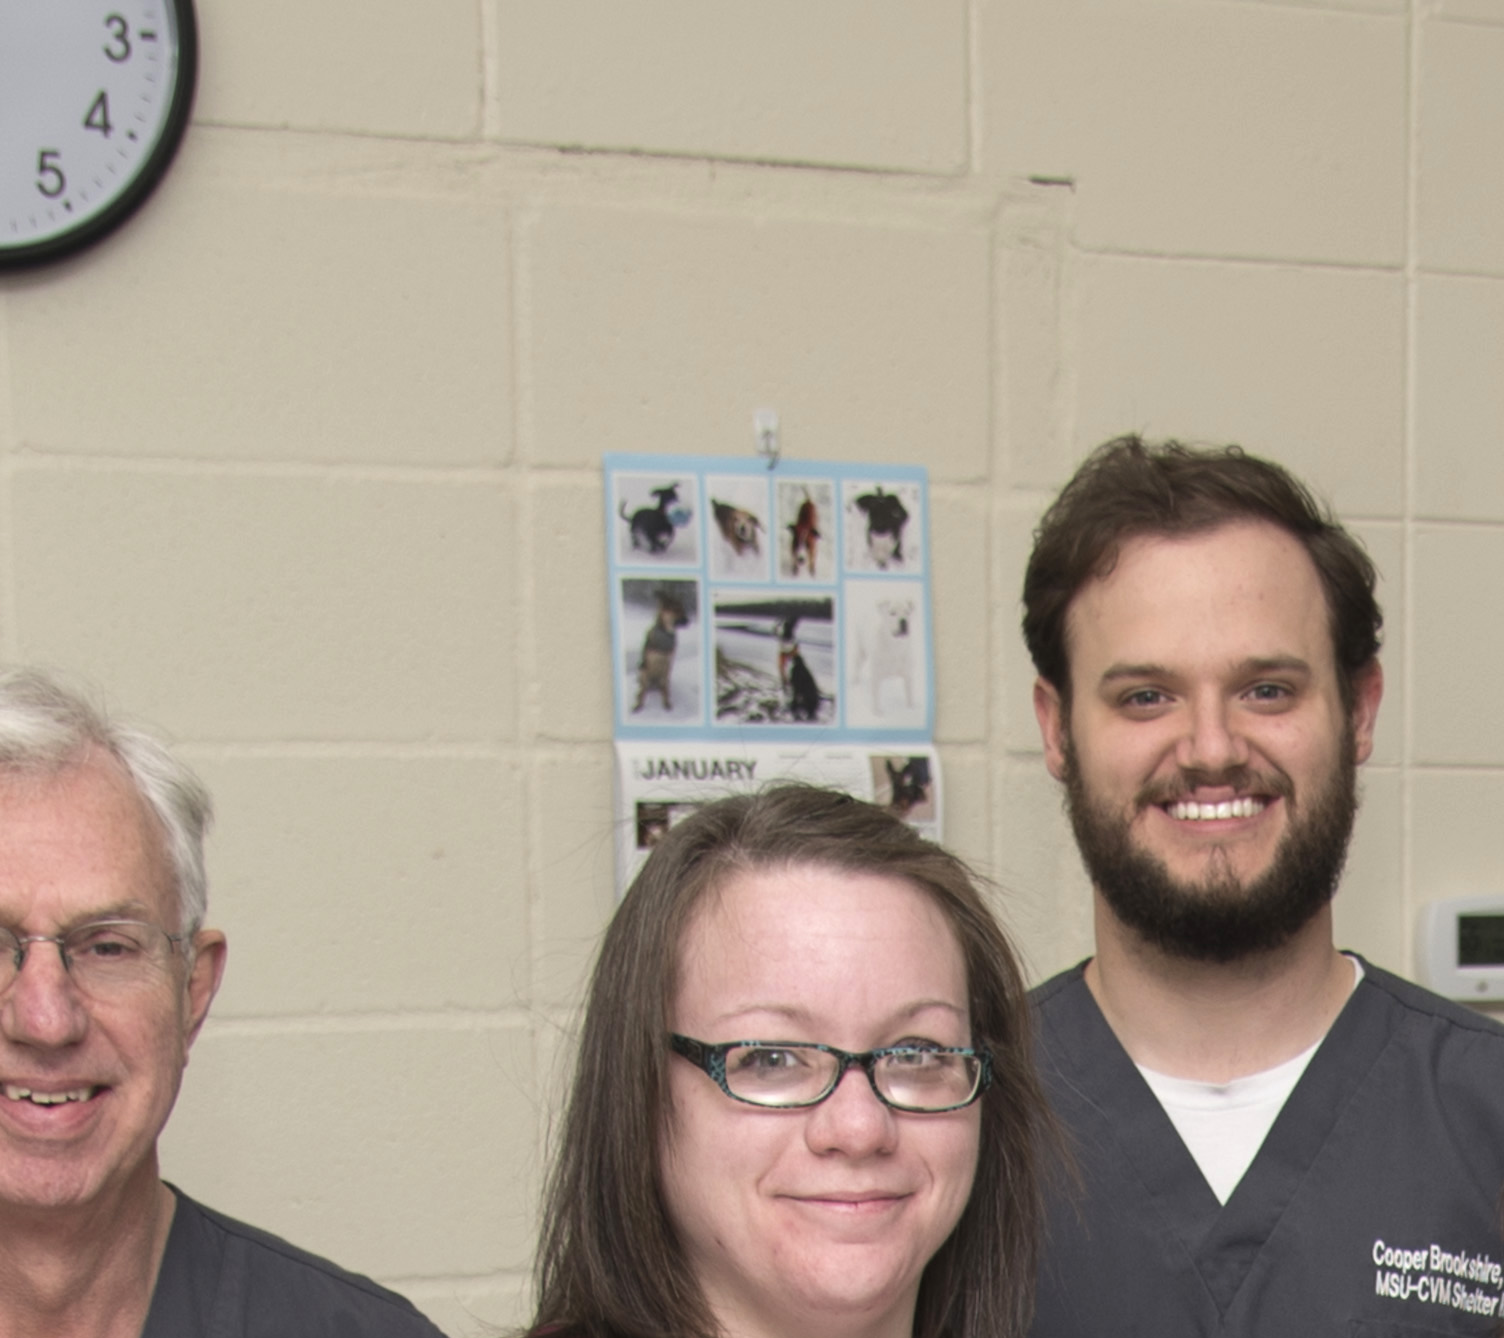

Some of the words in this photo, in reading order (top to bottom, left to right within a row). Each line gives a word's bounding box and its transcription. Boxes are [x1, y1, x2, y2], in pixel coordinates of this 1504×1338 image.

[102, 14, 132, 63] 3
[84, 91, 114, 139] 4
[36, 149, 66, 198] 5
[641, 758, 758, 781] JANUARY
[1372, 1239, 1429, 1273] Cooper
[1430, 1244, 1504, 1286] Brookshire,
[1375, 1270, 1451, 1306] MSU-CVM
[1451, 1281, 1499, 1317] Shelter
